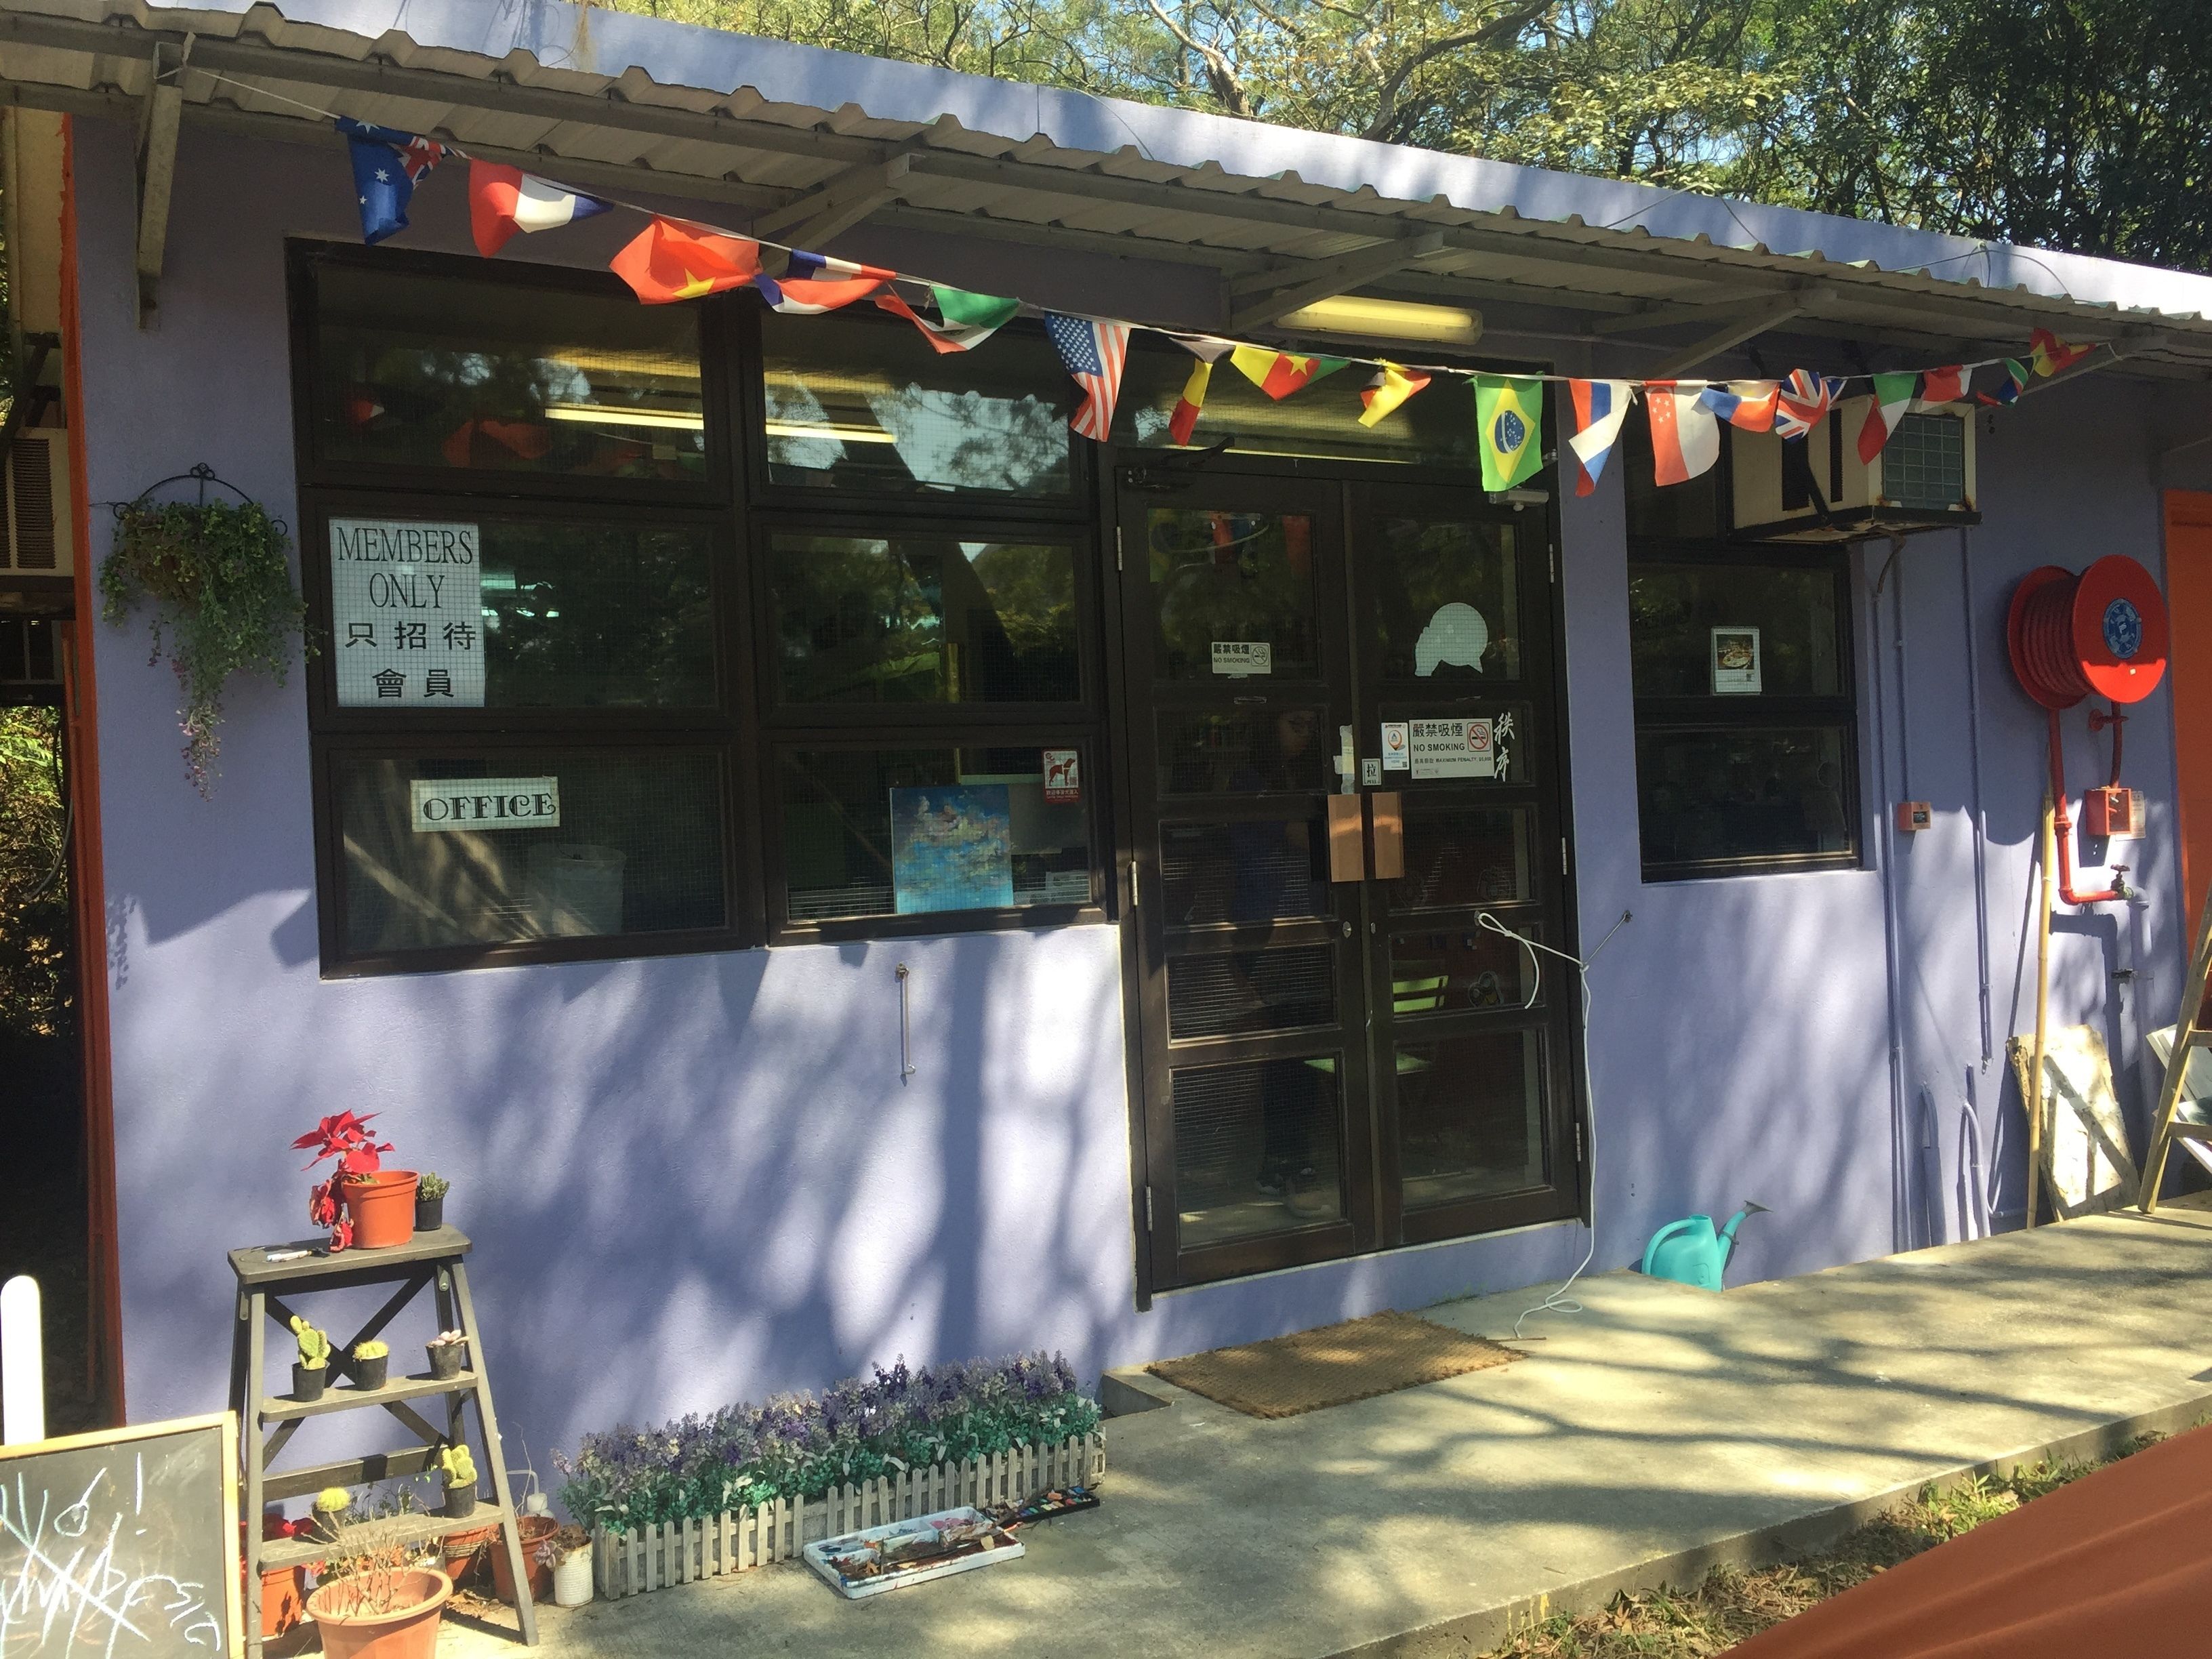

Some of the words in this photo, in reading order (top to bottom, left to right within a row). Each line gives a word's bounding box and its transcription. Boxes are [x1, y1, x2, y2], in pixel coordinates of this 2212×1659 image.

[337, 527, 473, 564] MEMBERS
[369, 573, 445, 609] ONLY
[344, 620, 476, 651] 只招待
[372, 668, 455, 699] 會員
[1412, 722, 1463, 738] 嚴禁吸煙
[1413, 744, 1425, 752] NO
[1427, 743, 1465, 752] SMOKING
[1367, 763, 1376, 777] 拉
[423, 792, 556, 821] OFFICE
